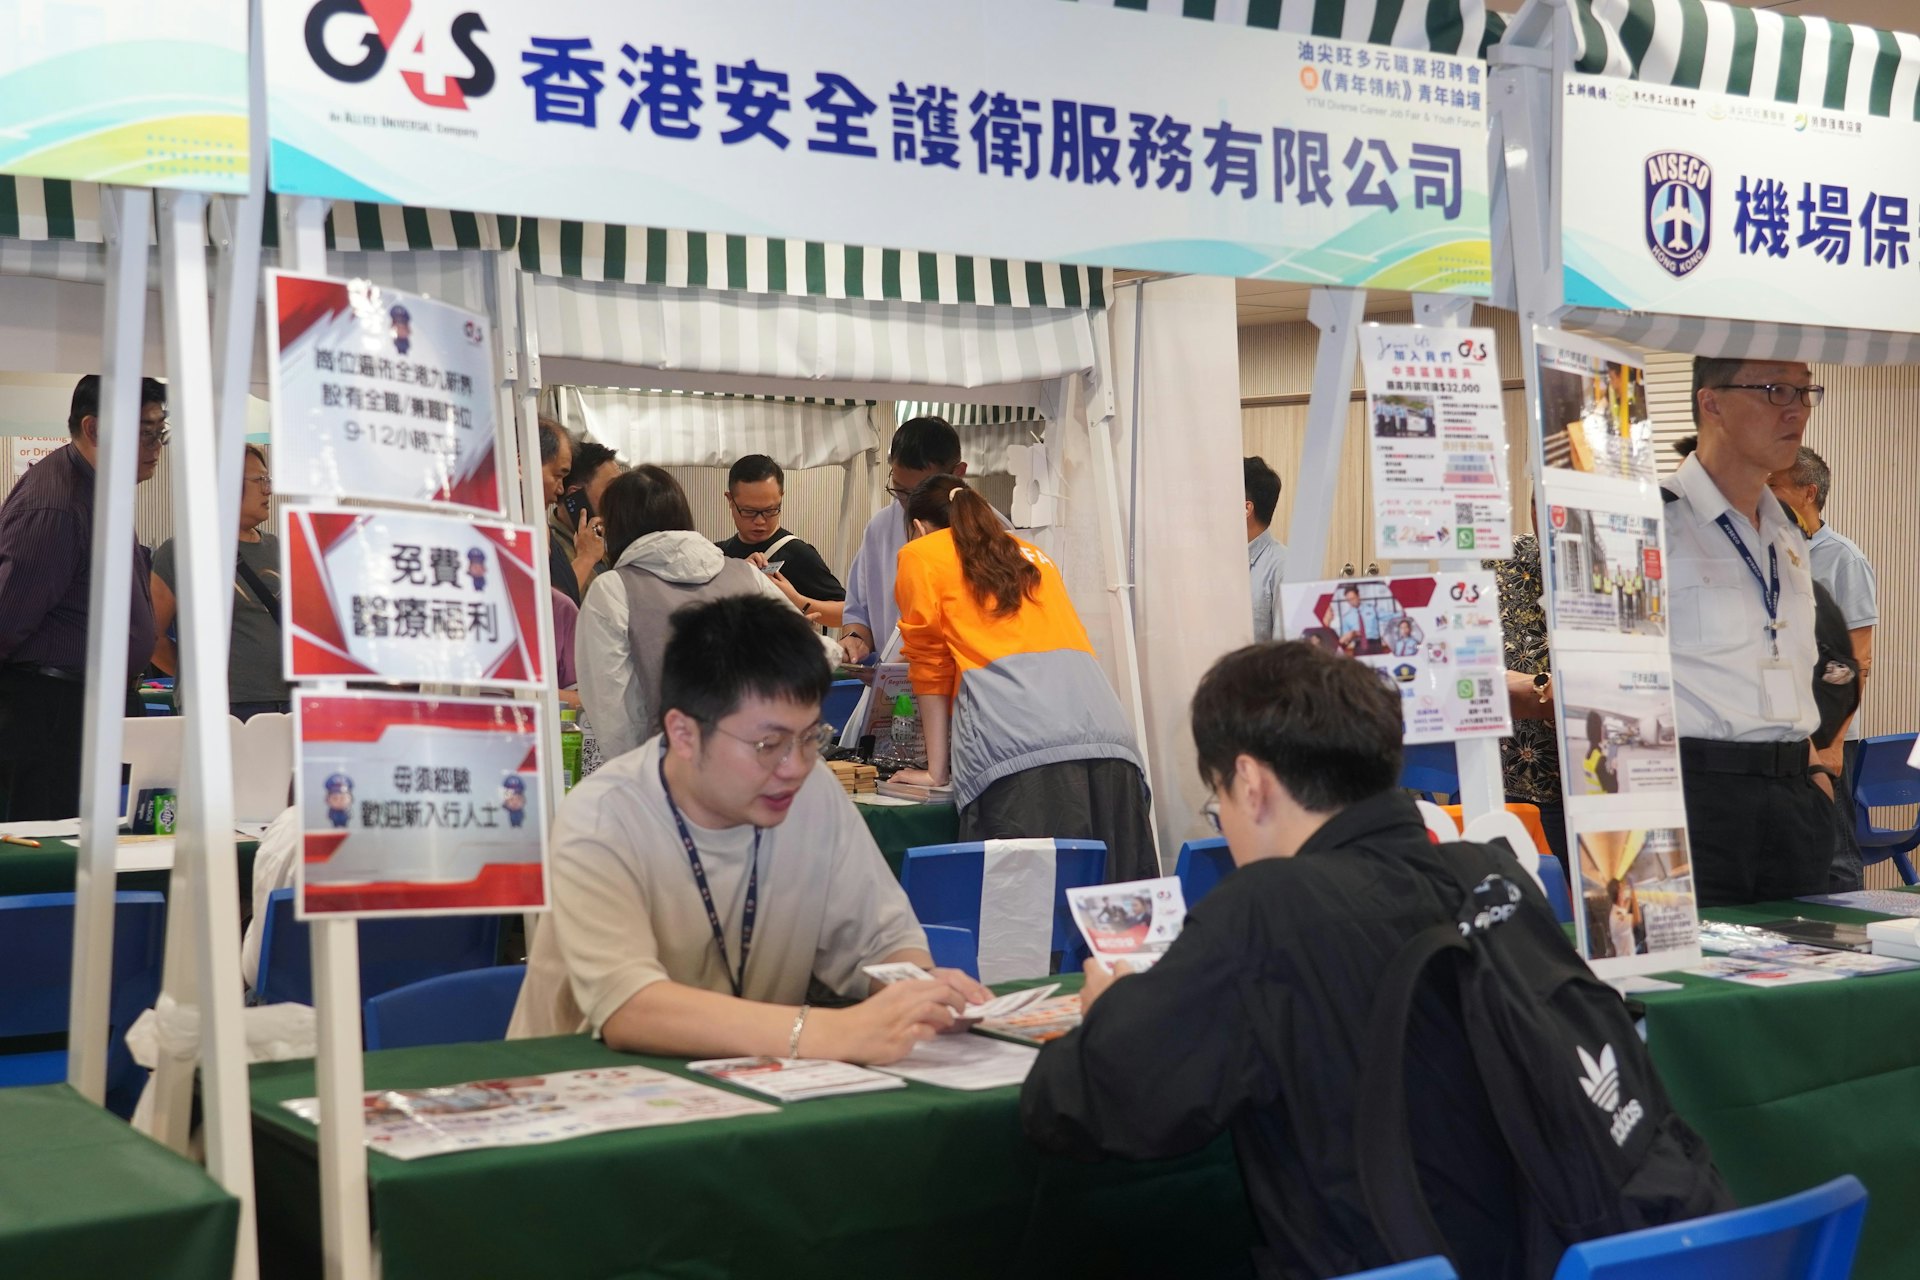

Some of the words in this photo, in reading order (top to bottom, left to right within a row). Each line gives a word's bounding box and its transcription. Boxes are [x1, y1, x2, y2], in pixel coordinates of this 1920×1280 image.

[304, 0, 496, 110] G4S
[1298, 41, 1481, 85] 油尖旺多元職業招聘會
[520, 36, 1463, 220] 香港安全護衛服務有限公司
[1647, 152, 1711, 191] AVSECO
[1733, 174, 1920, 269] 機場保
[1652, 243, 1677, 273] HONG
[1679, 249, 1704, 273] KONG
[33, 447, 58, 456] Drin
[1723, 524, 1740, 545] AVSECO
[391, 543, 463, 589] 免費
[352, 594, 498, 643] 醫療福利
[360, 800, 500, 828] 歡迎新入行人士
[1609, 1098, 1644, 1148] adidas
